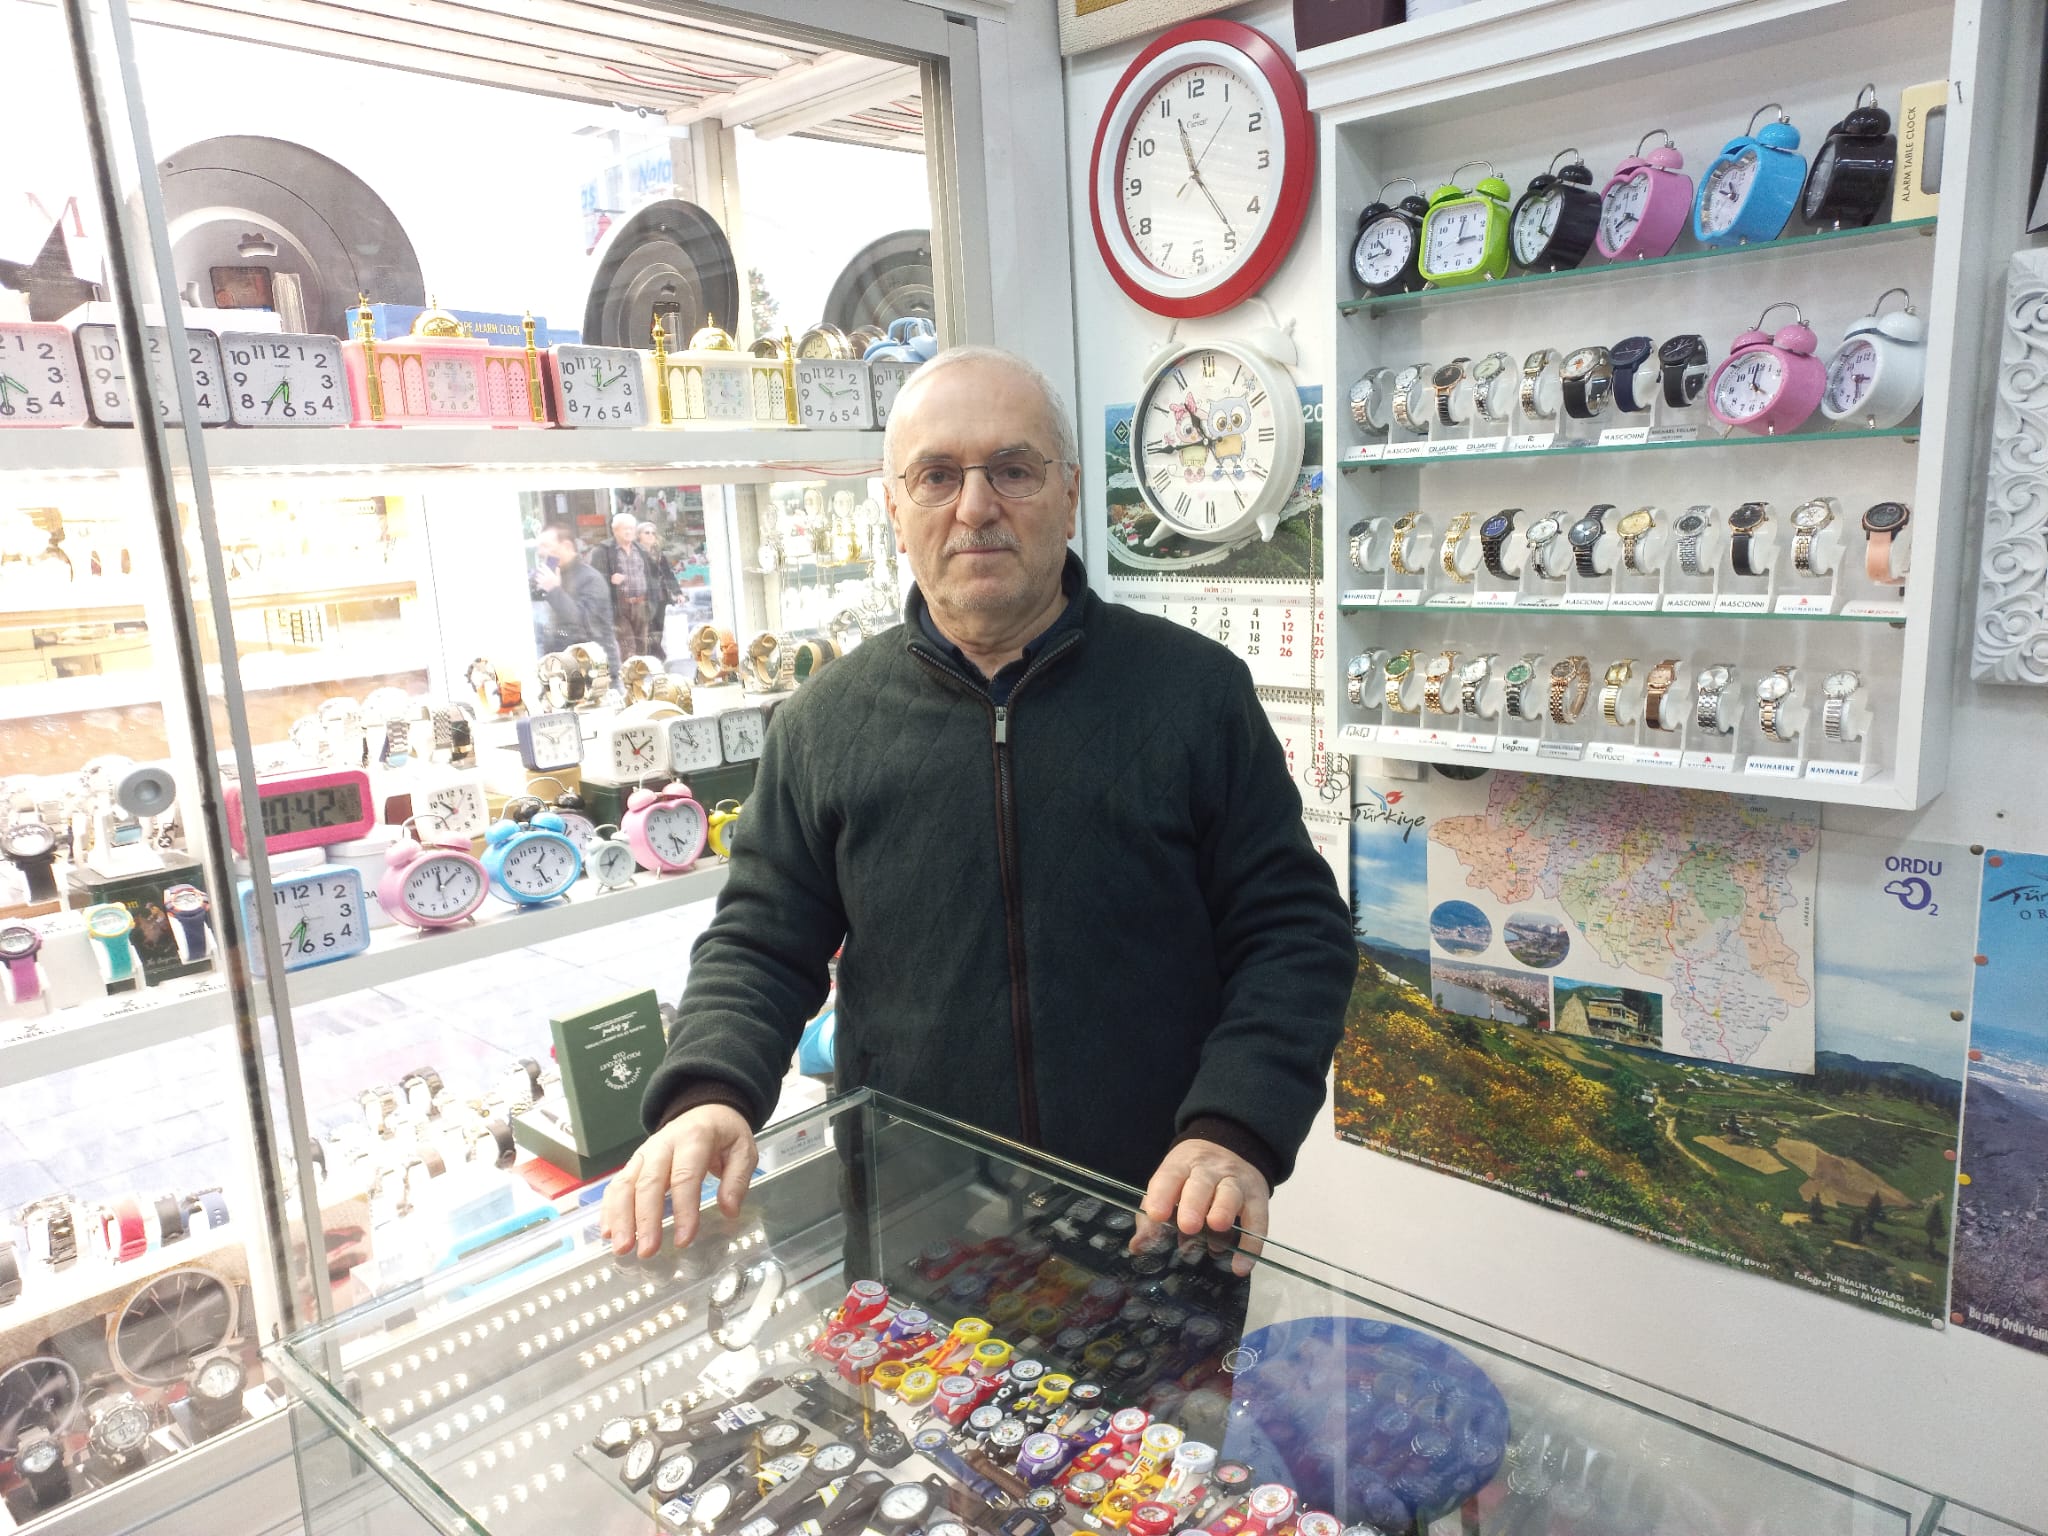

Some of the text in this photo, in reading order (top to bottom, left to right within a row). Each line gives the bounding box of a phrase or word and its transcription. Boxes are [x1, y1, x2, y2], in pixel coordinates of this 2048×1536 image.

[1187, 79, 1205, 98] 12
[1224, 83, 1229, 102] 1
[1160, 98, 1171, 118] 11
[1248, 112, 1262, 132] 2
[1138, 138, 1155, 158] 10
[1901, 106, 1917, 203] ALARM TABLE CLOCK
[1257, 150, 1270, 170] 3
[1130, 178, 1142, 197] 9
[1246, 196, 1260, 214] 4
[1139, 218, 1152, 236] 8
[1224, 231, 1237, 251] 5
[475, 322, 498, 335] ALARM
[501, 323, 521, 336] CLOCK
[37, 342, 53, 360] 2
[230, 350, 250, 367] 10
[253, 344, 266, 361] 11
[272, 344, 291, 360] 12
[299, 346, 305, 361] 1
[314, 353, 328, 369] 2
[560, 360, 575, 376] 10
[575, 356, 587, 371] 11
[589, 355, 603, 371] 12
[47, 367, 63, 384] 3
[618, 364, 628, 379] 2
[233, 372, 247, 387] 9
[321, 375, 334, 389] 3
[563, 381, 573, 394] 9
[623, 383, 632, 396] 3
[26, 397, 43, 415] 5
[50, 390, 65, 407] 4
[240, 393, 255, 409] 8
[321, 396, 334, 411] 4
[568, 399, 578, 413] 8
[262, 401, 275, 416] 7
[282, 401, 297, 417] 6
[304, 401, 317, 417] 5
[582, 405, 592, 419] 7
[598, 407, 607, 421] 6
[611, 405, 621, 420] 5
[624, 401, 633, 415] 4
[1612, 599, 1654, 608] MASCIONNI
[1667, 599, 1712, 608] MASCIONNI
[1719, 600, 1765, 610] MASCIONNI
[1163, 603, 1168, 614] 1
[1192, 604, 1198, 616] 2
[1222, 606, 1229, 617] 3
[1252, 607, 1260, 618] 4
[1285, 608, 1292, 620] 5
[1190, 617, 1295, 633] 9 10 11 12
[1219, 631, 1230, 642] 17
[1250, 632, 1261, 643] 18
[1281, 634, 1294, 646] 19
[1247, 644, 1260, 656] 25
[1279, 646, 1293, 658] 26
[1318, 729, 1323, 740] 1
[1285, 737, 1325, 752] 7 8
[1749, 762, 1796, 773] NAVIMARINE
[1810, 766, 1859, 778] NAVIMARINE
[1351, 802, 1426, 844] Türkiye
[1885, 856, 1943, 877] ORDU
[291, 885, 310, 898] 12
[317, 882, 324, 896] 1
[333, 884, 347, 898] 2
[274, 891, 286, 905] 11
[340, 903, 352, 918] 3
[340, 923, 353, 937] 4
[302, 938, 316, 953] 6
[323, 932, 336, 947] 5
[282, 942, 294, 957] 7
[1825, 1271, 1905, 1303] TURNALIK YAYLASI
[1793, 1270, 1832, 1291] Fotoğraf
[1838, 1285, 1859, 1298] Baki
[1860, 1291, 1935, 1321] MUSABAŞOĞLU
[1968, 1306, 1982, 1320] Bu
[1982, 1311, 2001, 1330] afiş
[2002, 1315, 2026, 1334] Ordu
